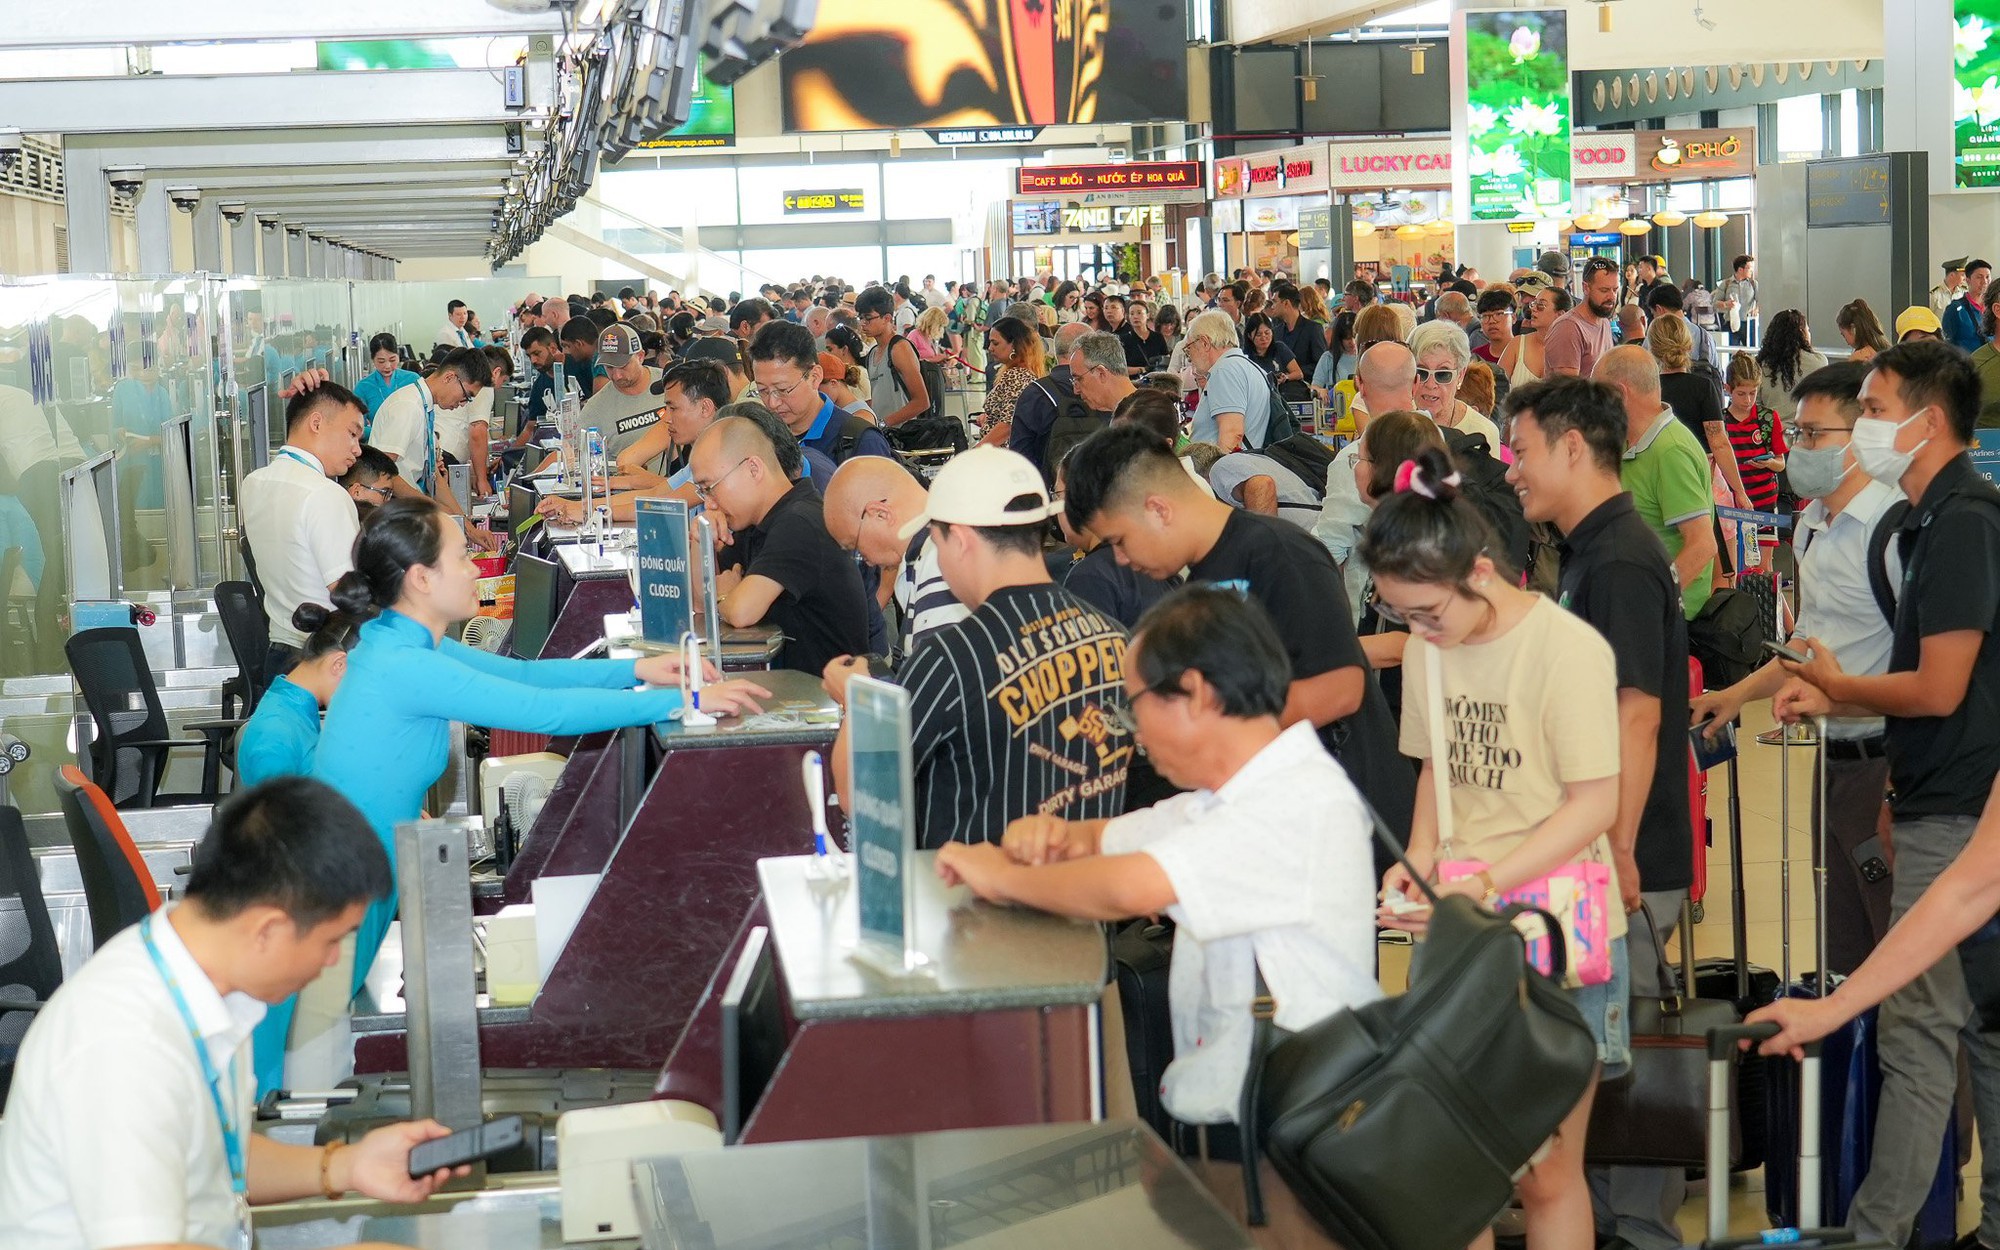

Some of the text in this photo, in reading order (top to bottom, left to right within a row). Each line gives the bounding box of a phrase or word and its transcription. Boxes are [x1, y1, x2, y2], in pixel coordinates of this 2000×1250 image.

[1341, 155, 1413, 174] LUCKY
[1034, 176, 1056, 186] CAFE
[1146, 173, 1164, 183] HOA
[1114, 205, 1164, 227] CAFE
[618, 411, 660, 432] SWOOSH.
[640, 554, 664, 570] ĐÓNG
[649, 583, 681, 598] CLOSED
[996, 612, 1111, 675] OLD SCHOOL
[1452, 719, 1499, 745] WHO
[1482, 744, 1522, 769] TOO
